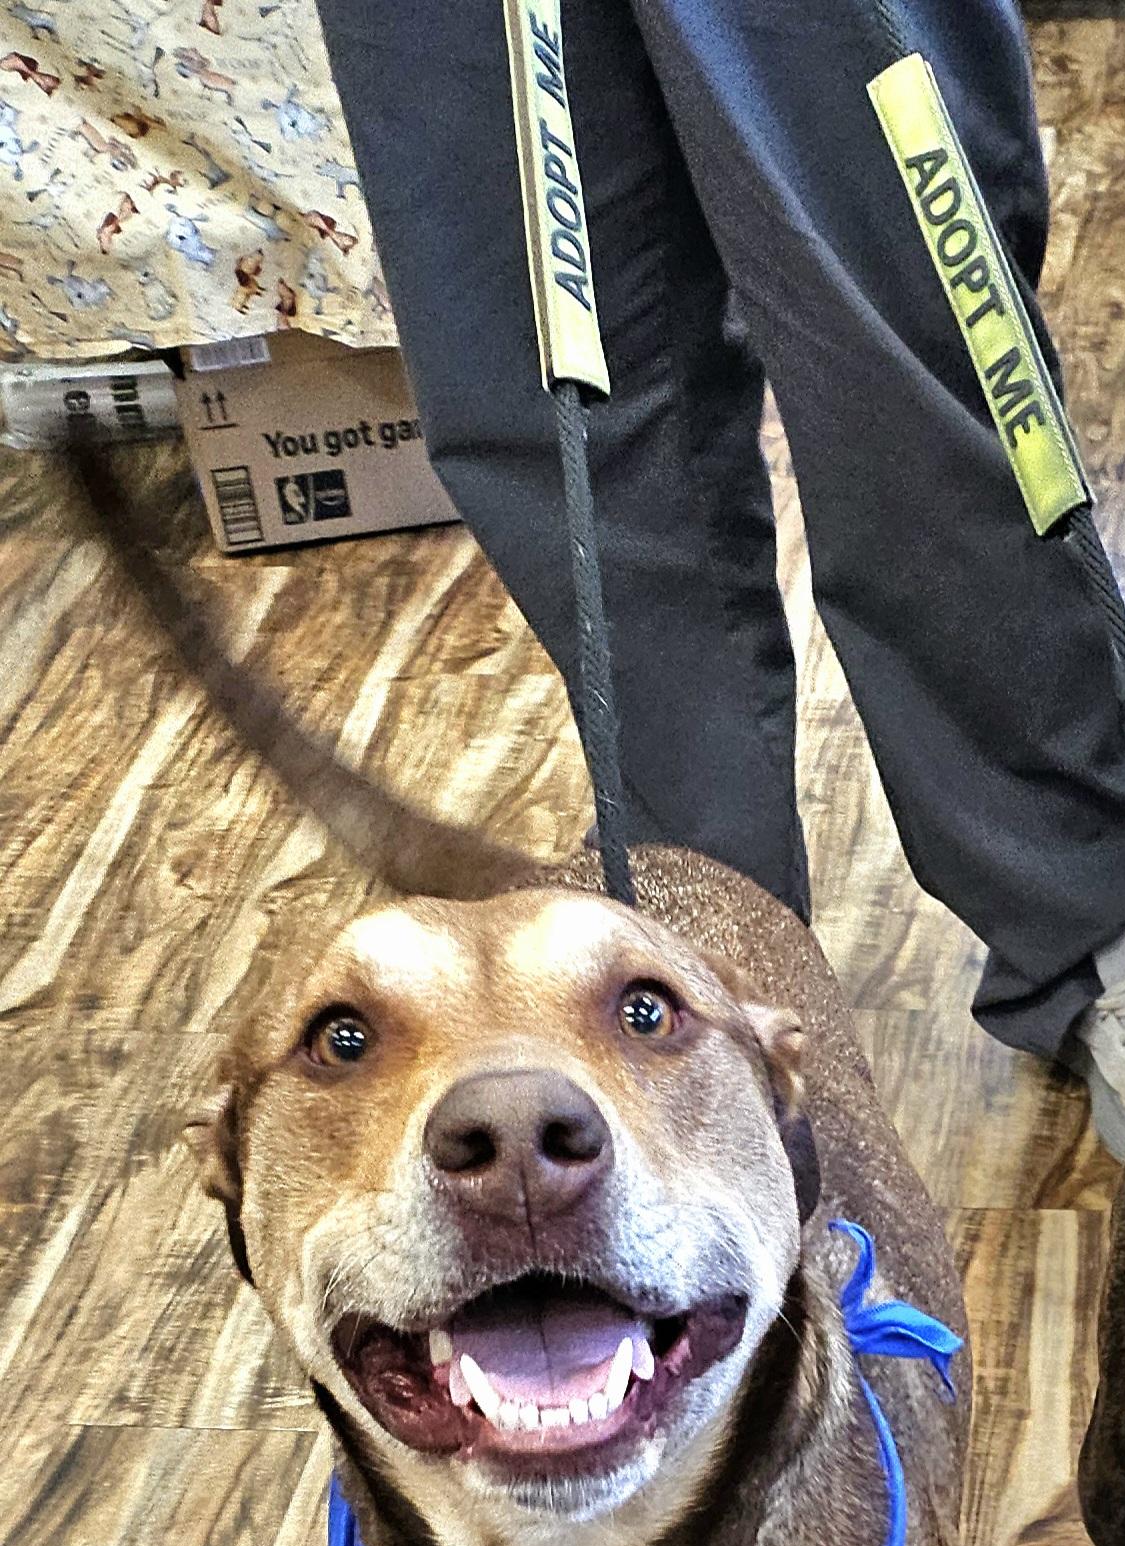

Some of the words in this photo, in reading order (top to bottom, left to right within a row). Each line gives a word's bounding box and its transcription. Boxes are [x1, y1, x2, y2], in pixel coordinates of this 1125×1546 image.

[529, 9, 566, 108] ME
[539, 118, 592, 312] ADOPT
[905, 147, 1006, 329] ADOPT
[985, 347, 1046, 449] ME
[261, 430, 319, 459] You
[323, 420, 375, 457] got
